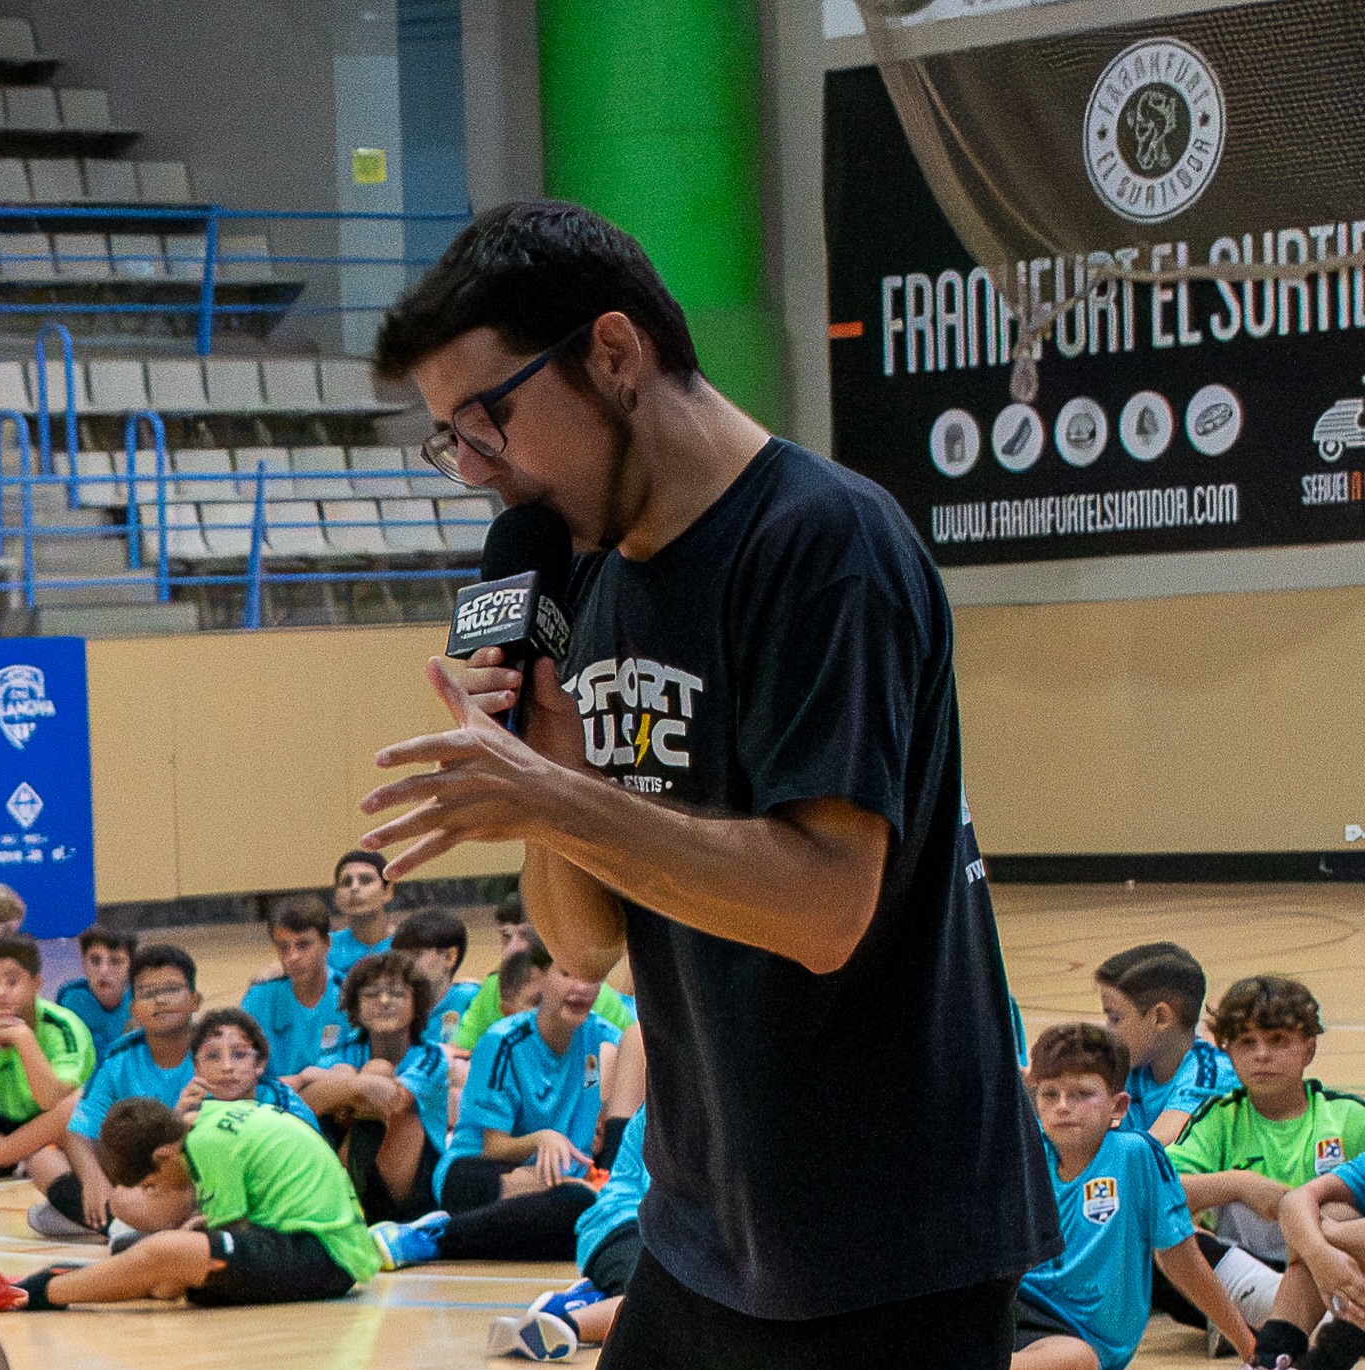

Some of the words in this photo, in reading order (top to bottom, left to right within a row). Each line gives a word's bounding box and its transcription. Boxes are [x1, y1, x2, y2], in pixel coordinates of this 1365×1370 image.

[1151, 242, 1203, 348] EL
[932, 483, 1238, 543] WWW.FRANKFURTELSURTIDOR.COM
[457, 588, 530, 619] ESPORT
[561, 657, 703, 718] SPORT
